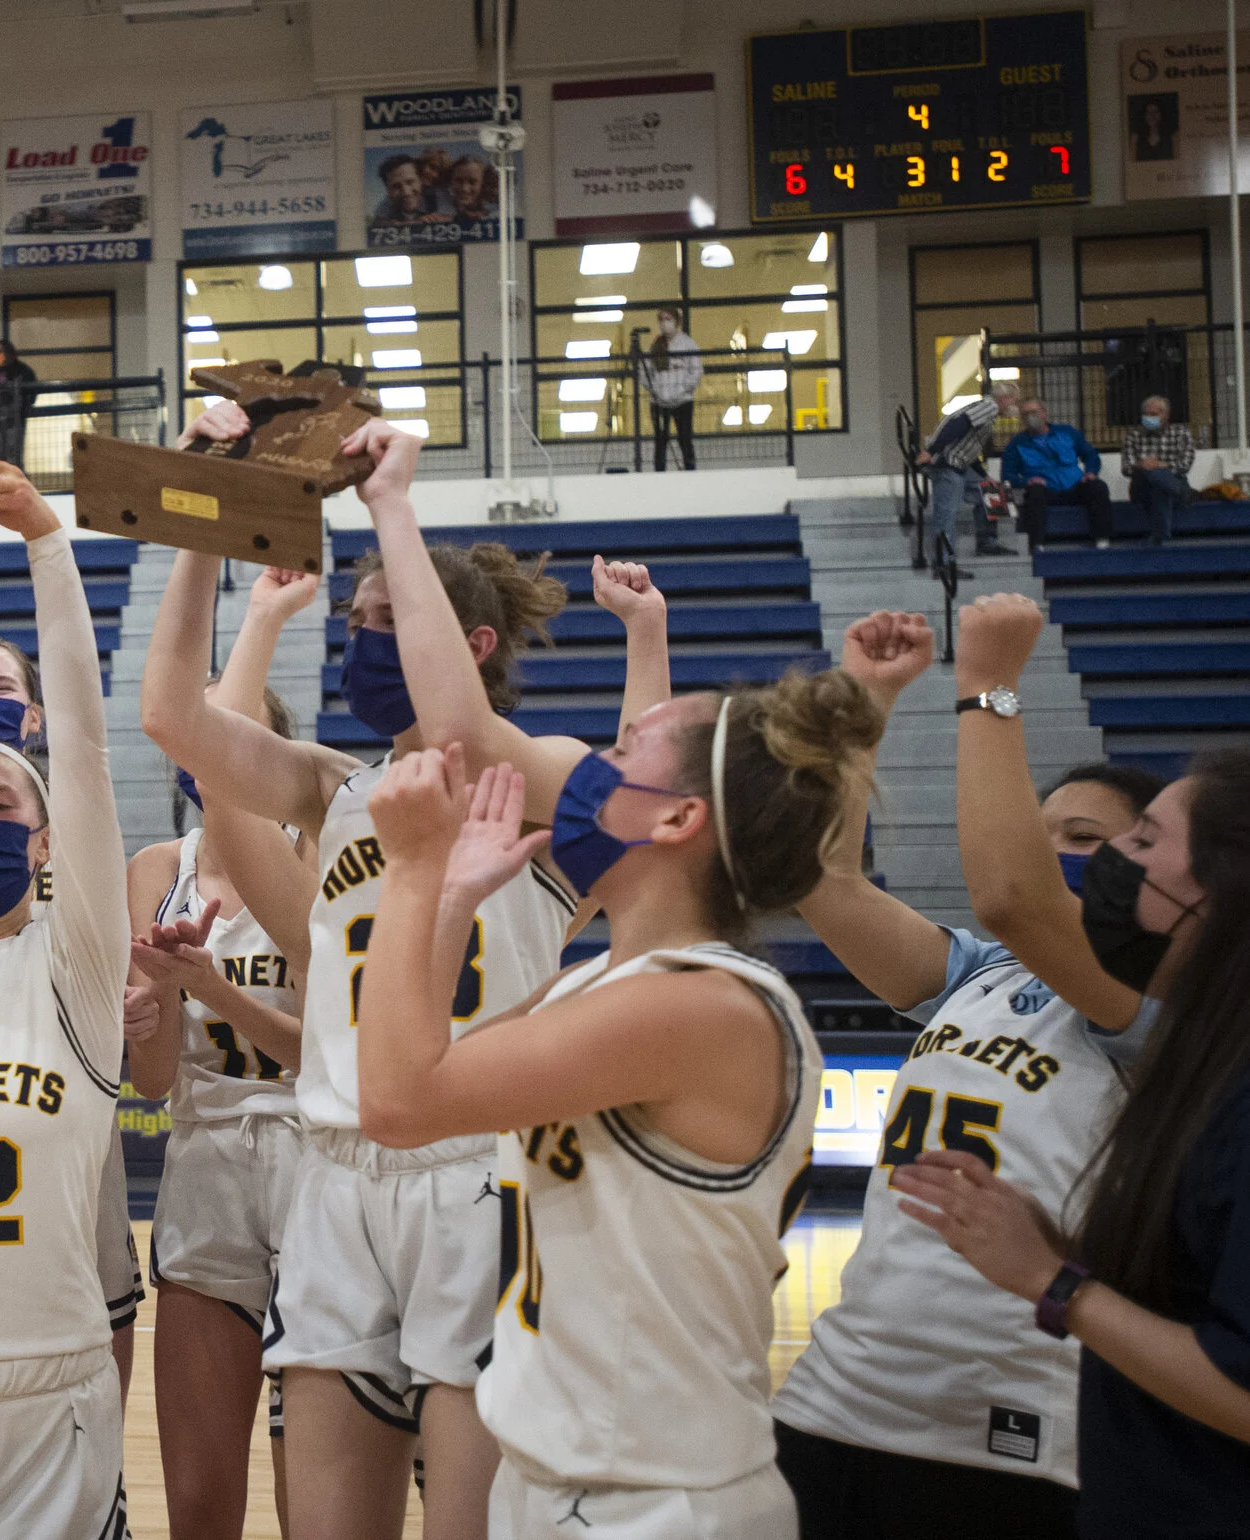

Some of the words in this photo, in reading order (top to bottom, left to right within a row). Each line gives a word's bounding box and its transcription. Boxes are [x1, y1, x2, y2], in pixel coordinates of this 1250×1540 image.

[1164, 43, 1224, 58] Saline
[772, 81, 838, 102] SALINE
[893, 84, 940, 97] PERIOD
[999, 64, 1062, 85] GUEST
[907, 103, 930, 130] 4
[5, 143, 78, 170] Load
[89, 142, 149, 164] One
[769, 149, 811, 163] FOULS
[874, 142, 923, 157] PLAYER
[932, 138, 965, 152] FOUL
[1030, 131, 1073, 146] FOULS
[572, 167, 612, 179] Saline
[615, 165, 659, 178] Urgent
[661, 162, 694, 174] Care
[785, 163, 808, 195] 6
[833, 163, 856, 190] 4
[906, 155, 926, 187] 3
[950, 155, 960, 182] 1
[987, 150, 1009, 182] 2
[1049, 145, 1070, 175] 7
[1031, 184, 1073, 199] SCORE
[16, 241, 138, 264] 800-957-4698
[118, 1109, 173, 1137] High
[878, 1085, 1004, 1190] 45
[1008, 1414, 1021, 1430] L
